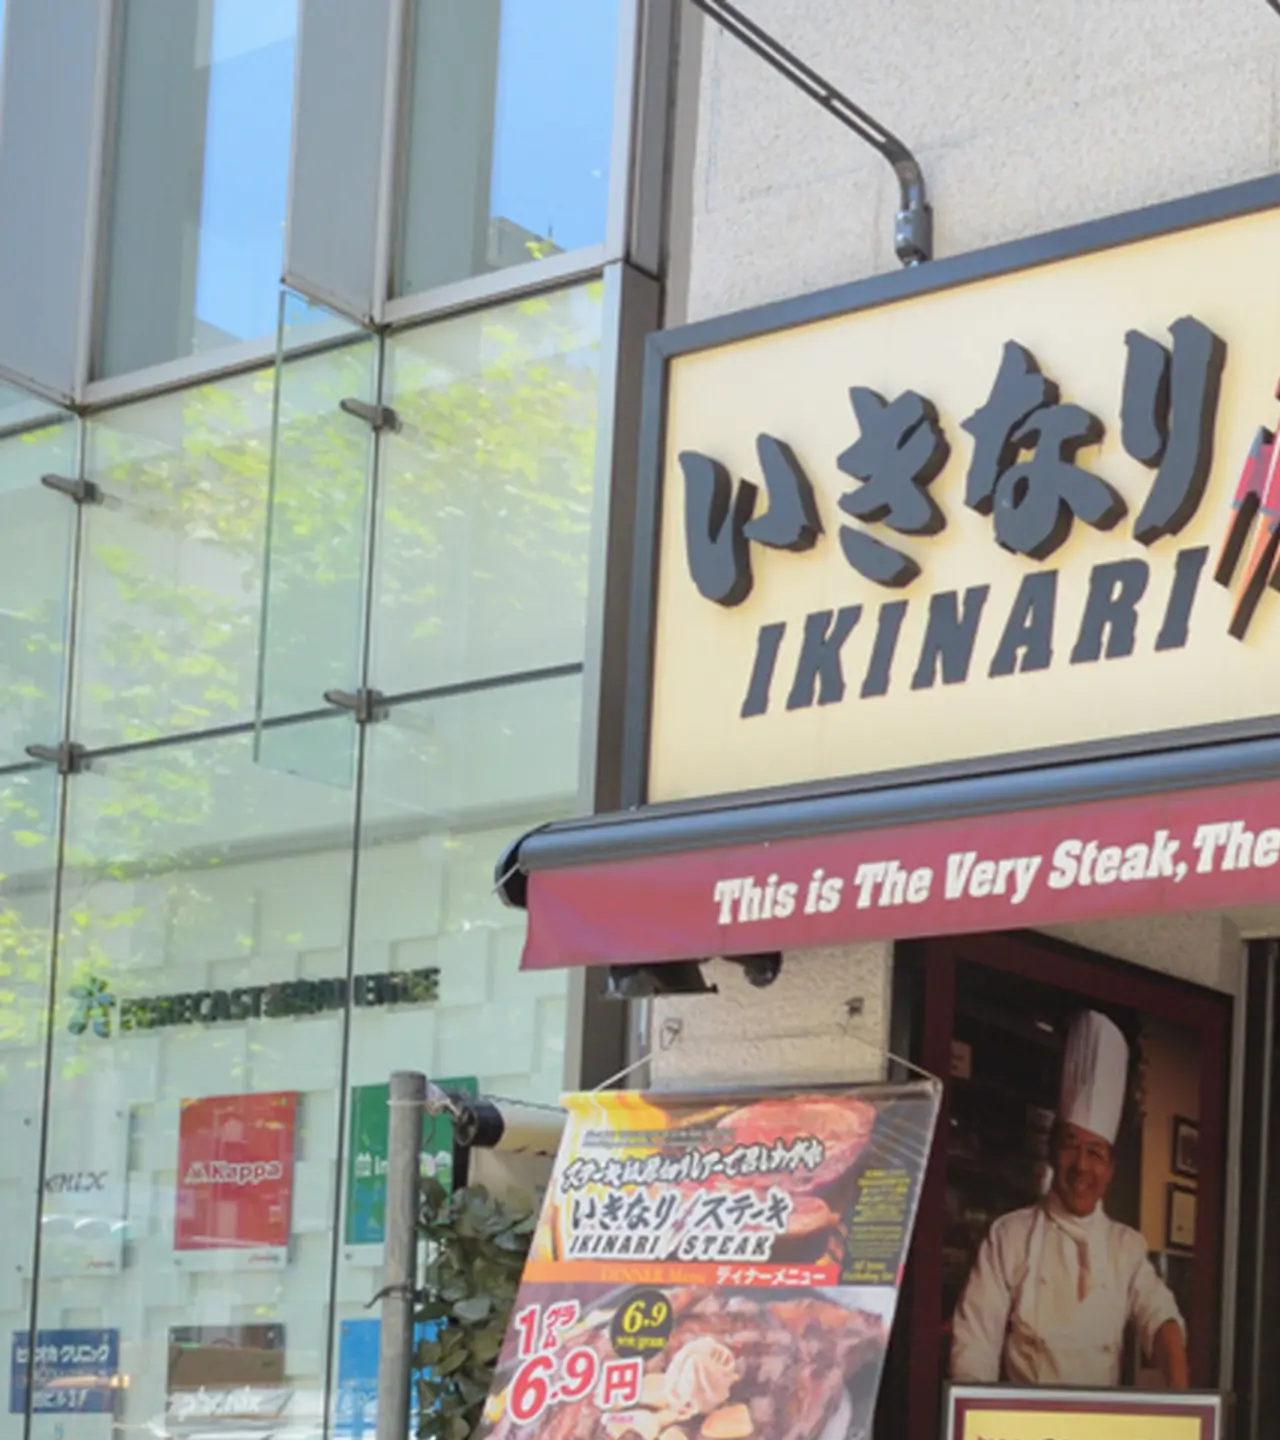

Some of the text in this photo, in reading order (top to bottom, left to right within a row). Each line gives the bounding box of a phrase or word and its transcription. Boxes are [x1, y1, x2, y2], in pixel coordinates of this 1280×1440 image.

[677, 313, 1228, 606] いきなり
[739, 545, 1208, 718] IKINARI
[713, 876, 796, 926] This
[806, 874, 842, 917] is
[854, 857, 931, 909] The
[943, 850, 1038, 905] Very
[211, 1161, 281, 1185] Kappa
[572, 1190, 791, 1232] いきなり ステーキ
[570, 1235, 772, 1257] IKINARI STEAK
[715, 1266, 826, 1285] ディナーメニュー
[622, 1300, 668, 1334] 6.9
[602, 1361, 641, 1406] 円
